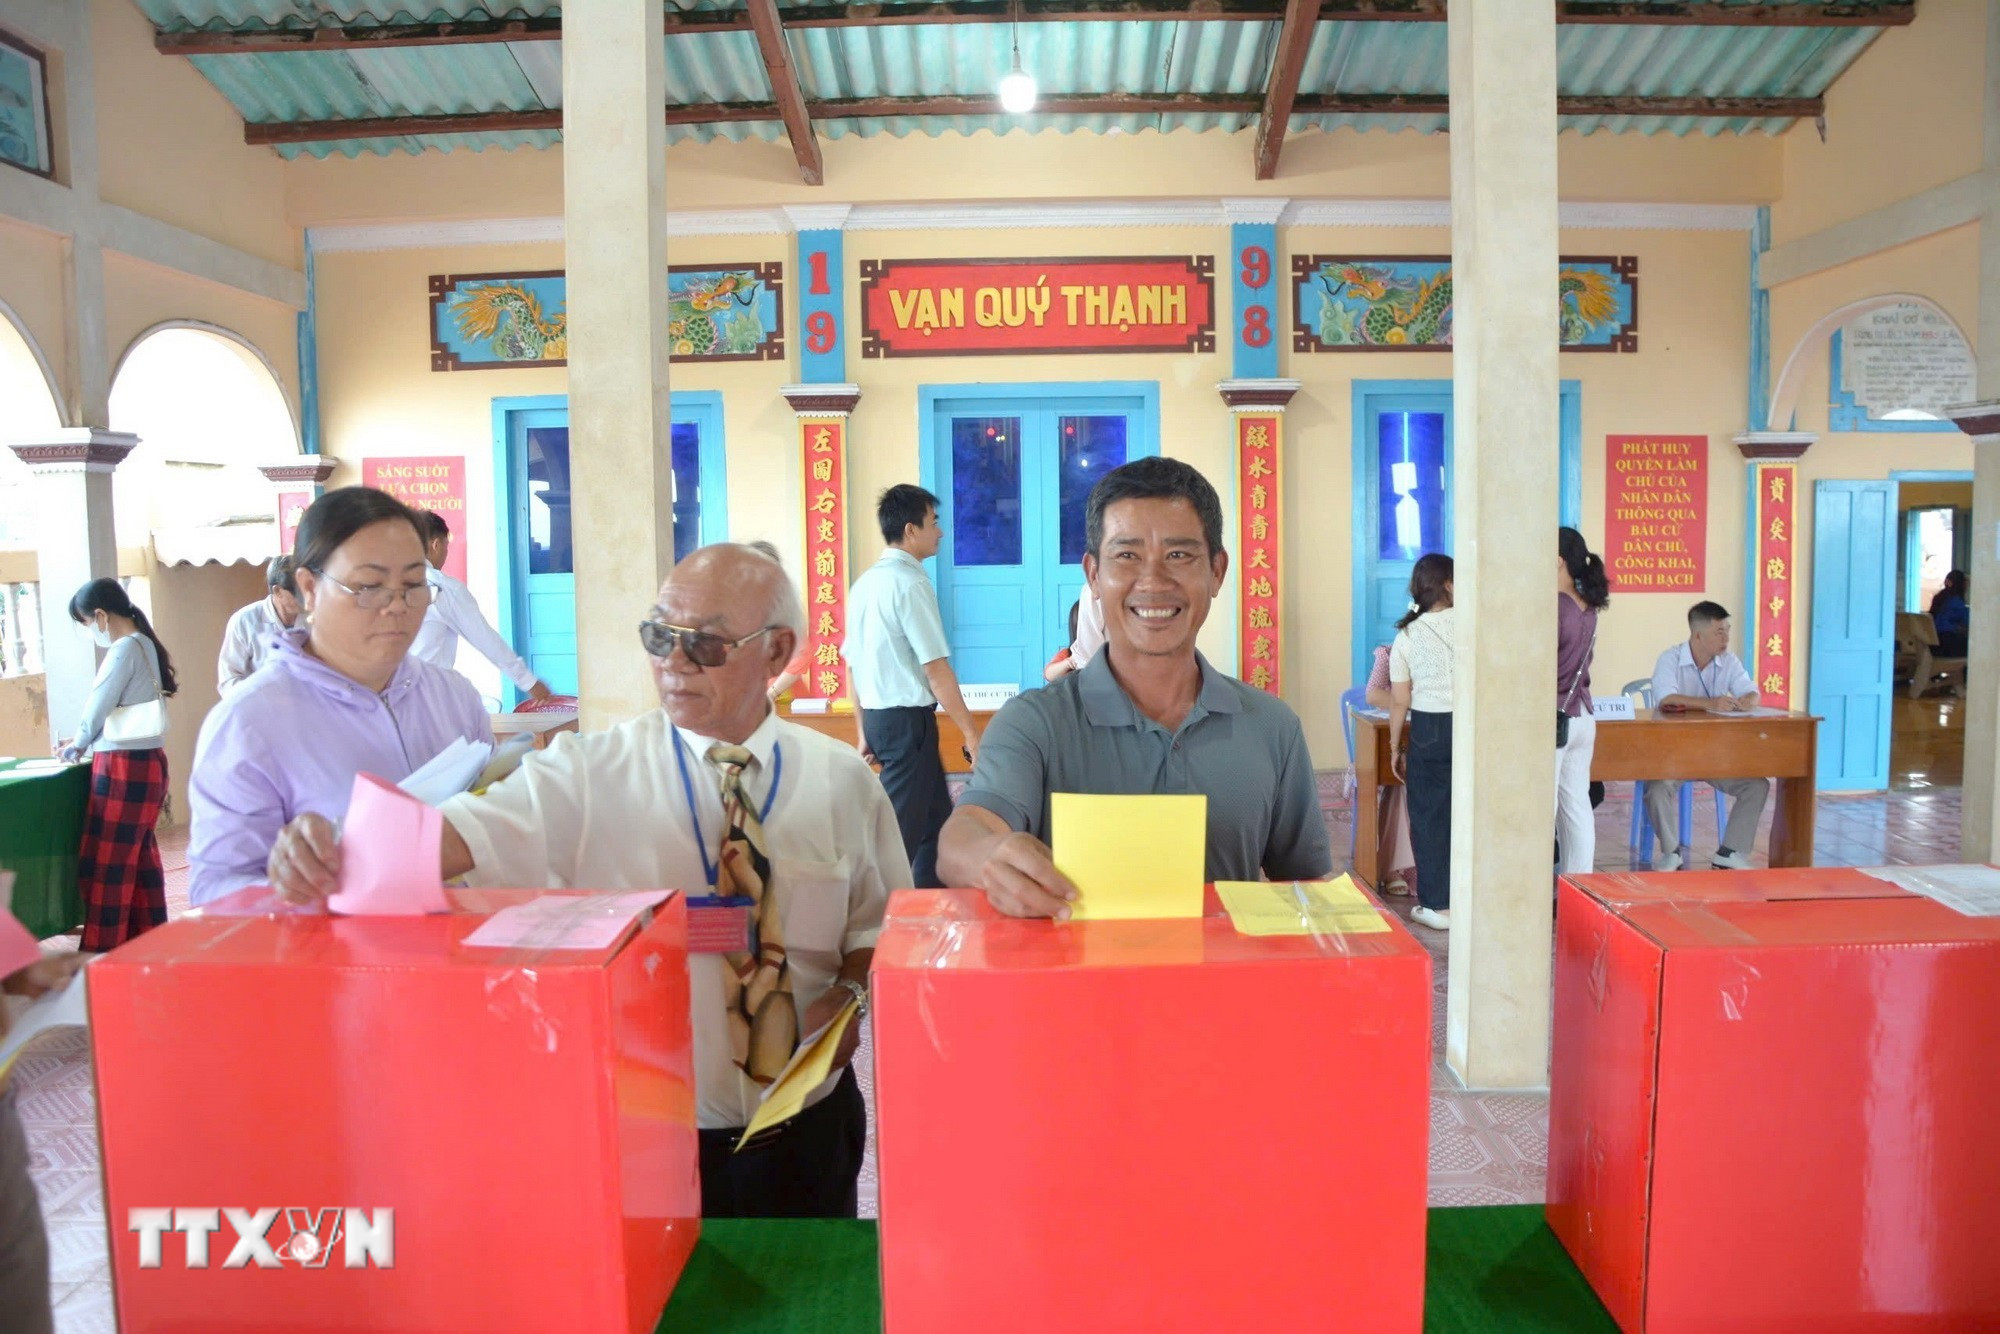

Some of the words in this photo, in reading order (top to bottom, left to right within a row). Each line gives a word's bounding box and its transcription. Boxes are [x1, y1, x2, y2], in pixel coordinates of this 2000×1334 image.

[889, 288, 965, 336] VẠN
[974, 274, 1051, 328] QUÝ
[1061, 285, 1187, 333] THẠNH
[1622, 440, 1659, 455] PHÁT
[1662, 443, 1691, 455] HUY
[376, 463, 412, 478] SÁNG
[415, 463, 450, 478] SUỐT
[1615, 456, 1663, 473] QUYỀN
[1666, 457, 1698, 471] LÀM
[1626, 473, 1655, 487] CHỦ
[1658, 473, 1687, 487] CỦA
[410, 482, 449, 496] CHỌN
[1621, 489, 1660, 503] NHÂN
[1663, 489, 1692, 503] DÂN
[1615, 506, 1664, 520] THÔNG
[1667, 508, 1697, 523] QUA
[1624, 538, 1652, 552] DÂN
[1615, 554, 1654, 568] CÔNG
[1617, 574, 1653, 586] MINH
[1656, 574, 1694, 588] BẠCH
[1609, 703, 1626, 712] TRI
